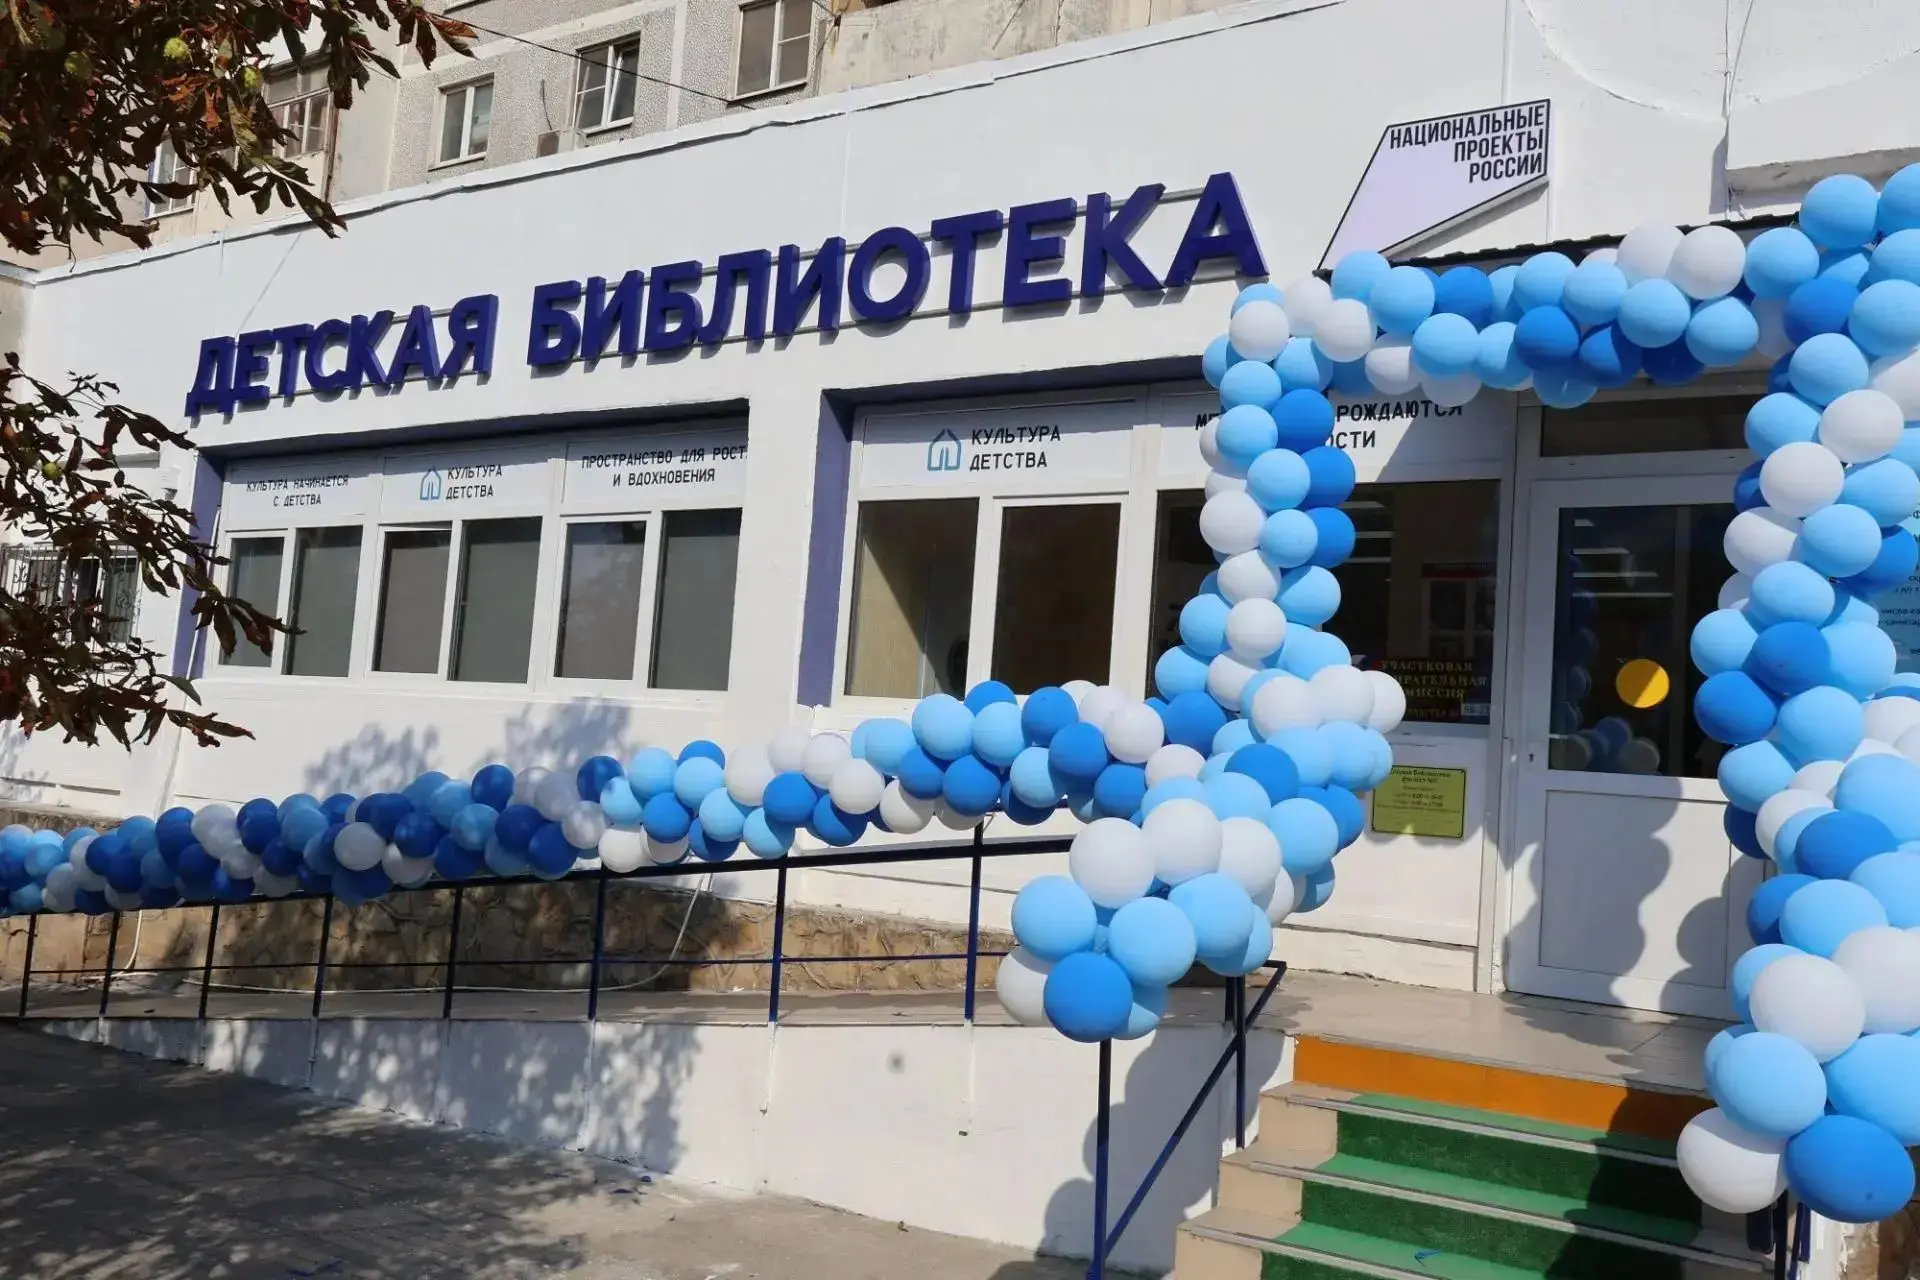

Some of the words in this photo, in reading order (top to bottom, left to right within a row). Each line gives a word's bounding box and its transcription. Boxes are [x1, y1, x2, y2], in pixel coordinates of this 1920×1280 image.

[1390, 104, 1545, 149] НАЦИОНАЛЬНЫЕ
[1454, 129, 1543, 162] ПРОЕКТЫ
[1469, 152, 1542, 183] РОССИИ
[185, 294, 499, 417] ДЕТСКАЯ
[527, 172, 1269, 368] БИБЛИОТЕКА
[971, 425, 1061, 445] КУЛЬТУРА
[581, 450, 673, 469] ПРОСТРАНСТВО
[680, 448, 705, 463] ДЛЯ
[712, 445, 748, 461] РОСТ
[969, 451, 1048, 471] ДЕТСТВА
[447, 464, 503, 480] КУЛЬТУРА
[612, 473, 621, 486] И
[628, 468, 716, 486] ВДОХНОВЕНИЯ
[246, 478, 289, 492] КУЛЬТУРА
[293, 474, 349, 489] НАЧИНАЕТСЯ
[445, 484, 495, 500] ДЕТСТВА
[273, 495, 279, 507] С
[283, 493, 322, 507] ДЕТСТВА
